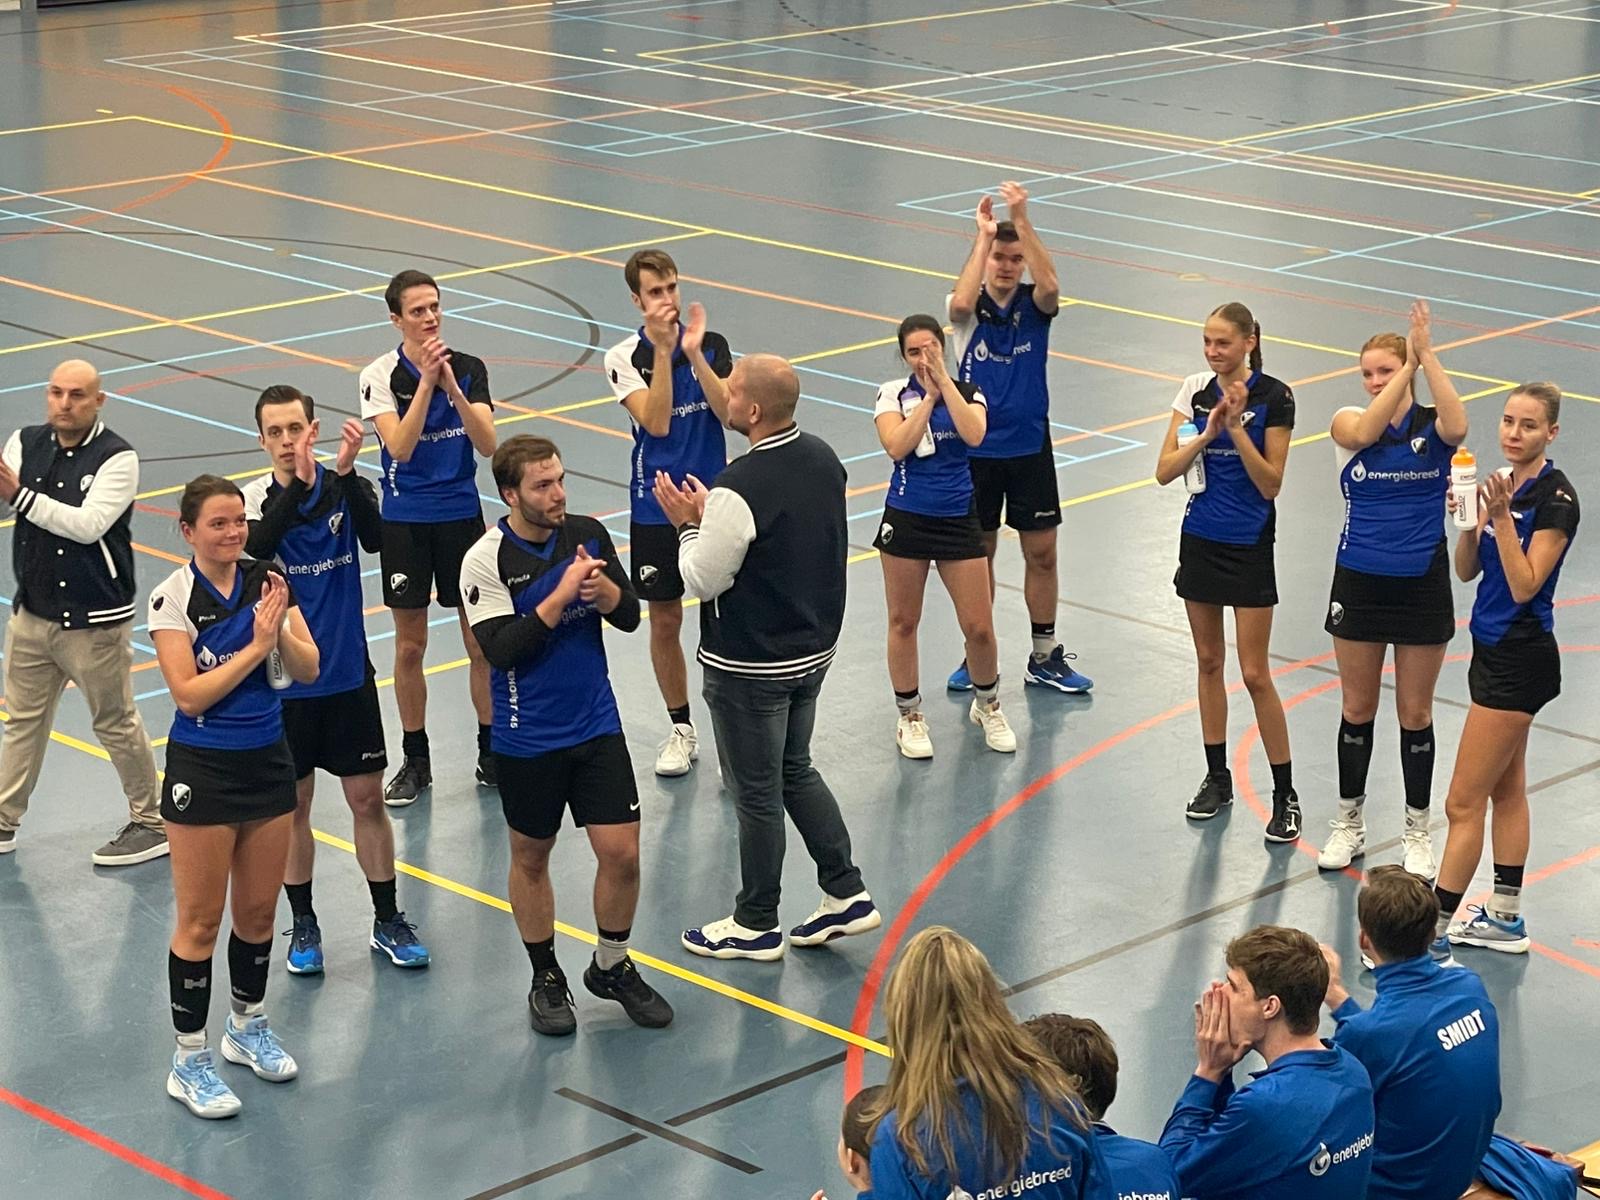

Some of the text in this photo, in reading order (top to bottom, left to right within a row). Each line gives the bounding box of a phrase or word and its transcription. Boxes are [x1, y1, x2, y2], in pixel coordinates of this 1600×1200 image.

[1368, 469, 1440, 482] energiebreed
[510, 713, 519, 729] '45
[1436, 1008, 1486, 1051] SMIDT
[976, 1161, 1072, 1200] energiebreed
